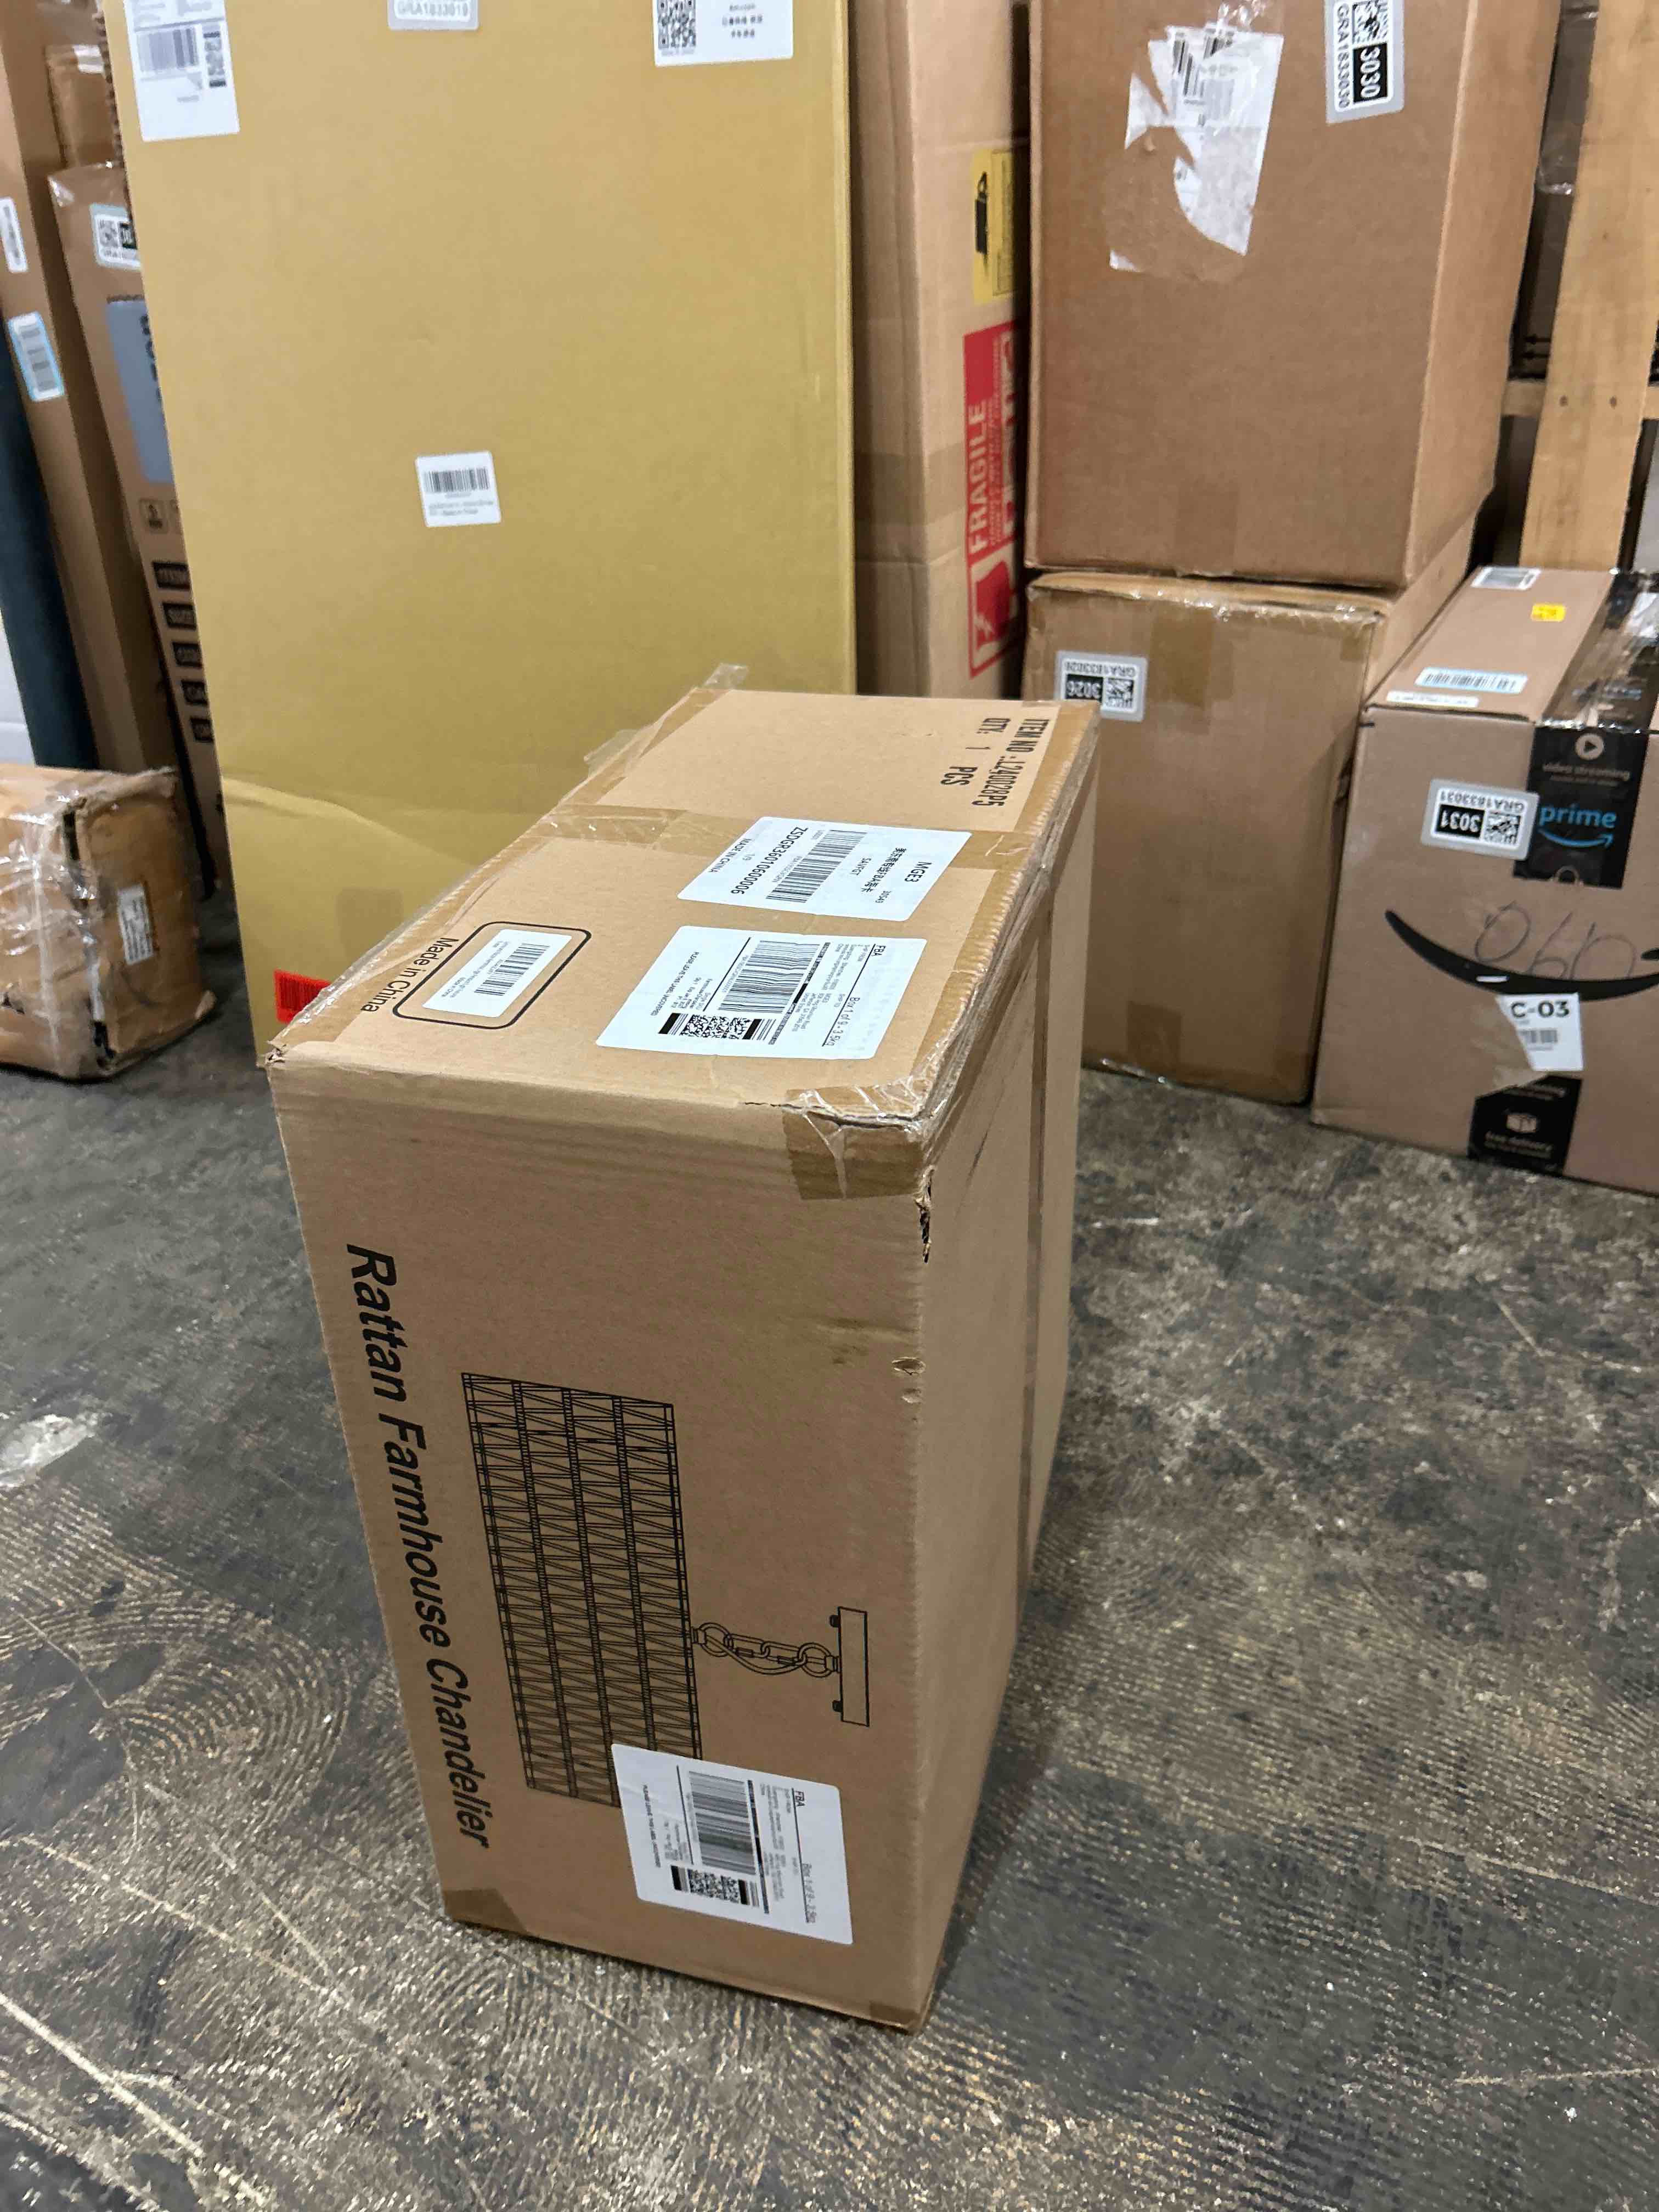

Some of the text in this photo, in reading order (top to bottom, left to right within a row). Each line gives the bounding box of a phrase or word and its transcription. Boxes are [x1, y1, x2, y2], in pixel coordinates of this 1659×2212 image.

[1337, 3, 1350, 108] GRA1833030
[1360, 46, 1380, 98] 3030
[968, 399, 989, 555] FRAGILE
[976, 718, 1011, 734] QTY:
[1014, 719, 1050, 738] ITEM
[940, 766, 978, 786] PCS
[1440, 791, 1525, 814] GRA1833031
[1440, 809, 1481, 833] 3031
[1539, 803, 1617, 829] prime
[732, 838, 752, 852] MADE
[709, 857, 731, 873] CHINA
[731, 827, 808, 894] ZSDGR36010600006
[902, 861, 932, 882] MGE3
[413, 938, 460, 966] Made
[871, 945, 887, 956] FBA
[398, 967, 427, 978] in
[359, 980, 411, 1012] China
[845, 997, 860, 1008] Box
[1510, 1001, 1570, 1018] C-03
[347, 1244, 493, 1849] Rattan Farmhouse Chandelier
[794, 1790, 805, 1809] FBA
